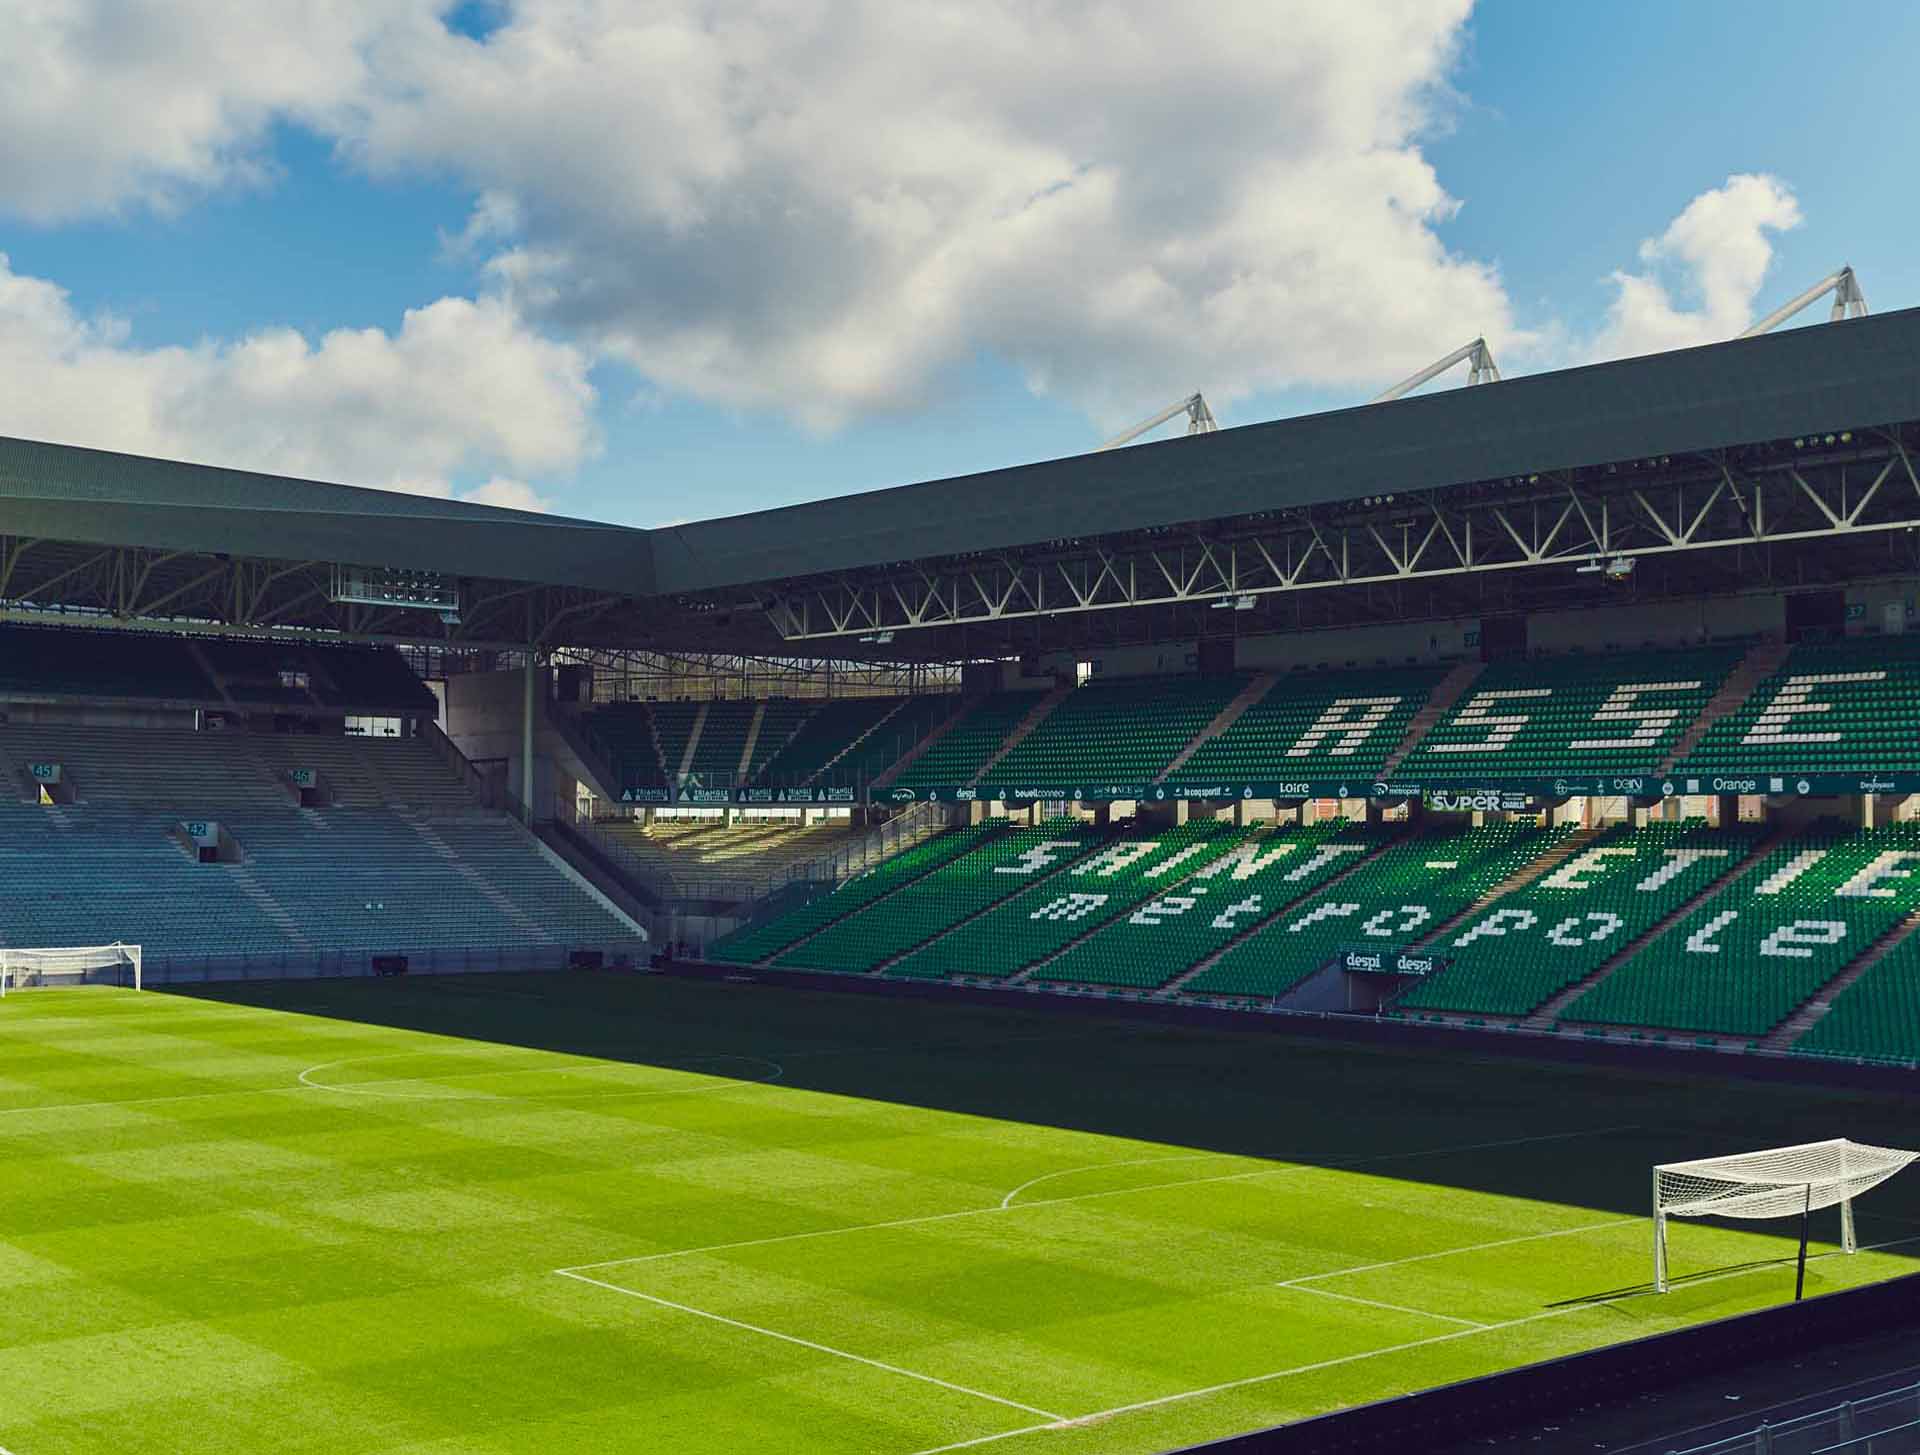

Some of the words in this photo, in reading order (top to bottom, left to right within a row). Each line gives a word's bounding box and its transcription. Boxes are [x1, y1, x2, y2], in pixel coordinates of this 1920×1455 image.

[1284, 671, 1887, 757] ASSE
[36, 765, 51, 777] 45
[1280, 782, 1310, 793] Loire
[1713, 777, 1756, 793] Orange
[956, 788, 977, 799] despi
[1190, 788, 1202, 798] coq
[1202, 786, 1221, 798] sportif
[190, 824, 207, 836] 42
[1346, 952, 1382, 971] despi
[1397, 955, 1433, 975] despi
